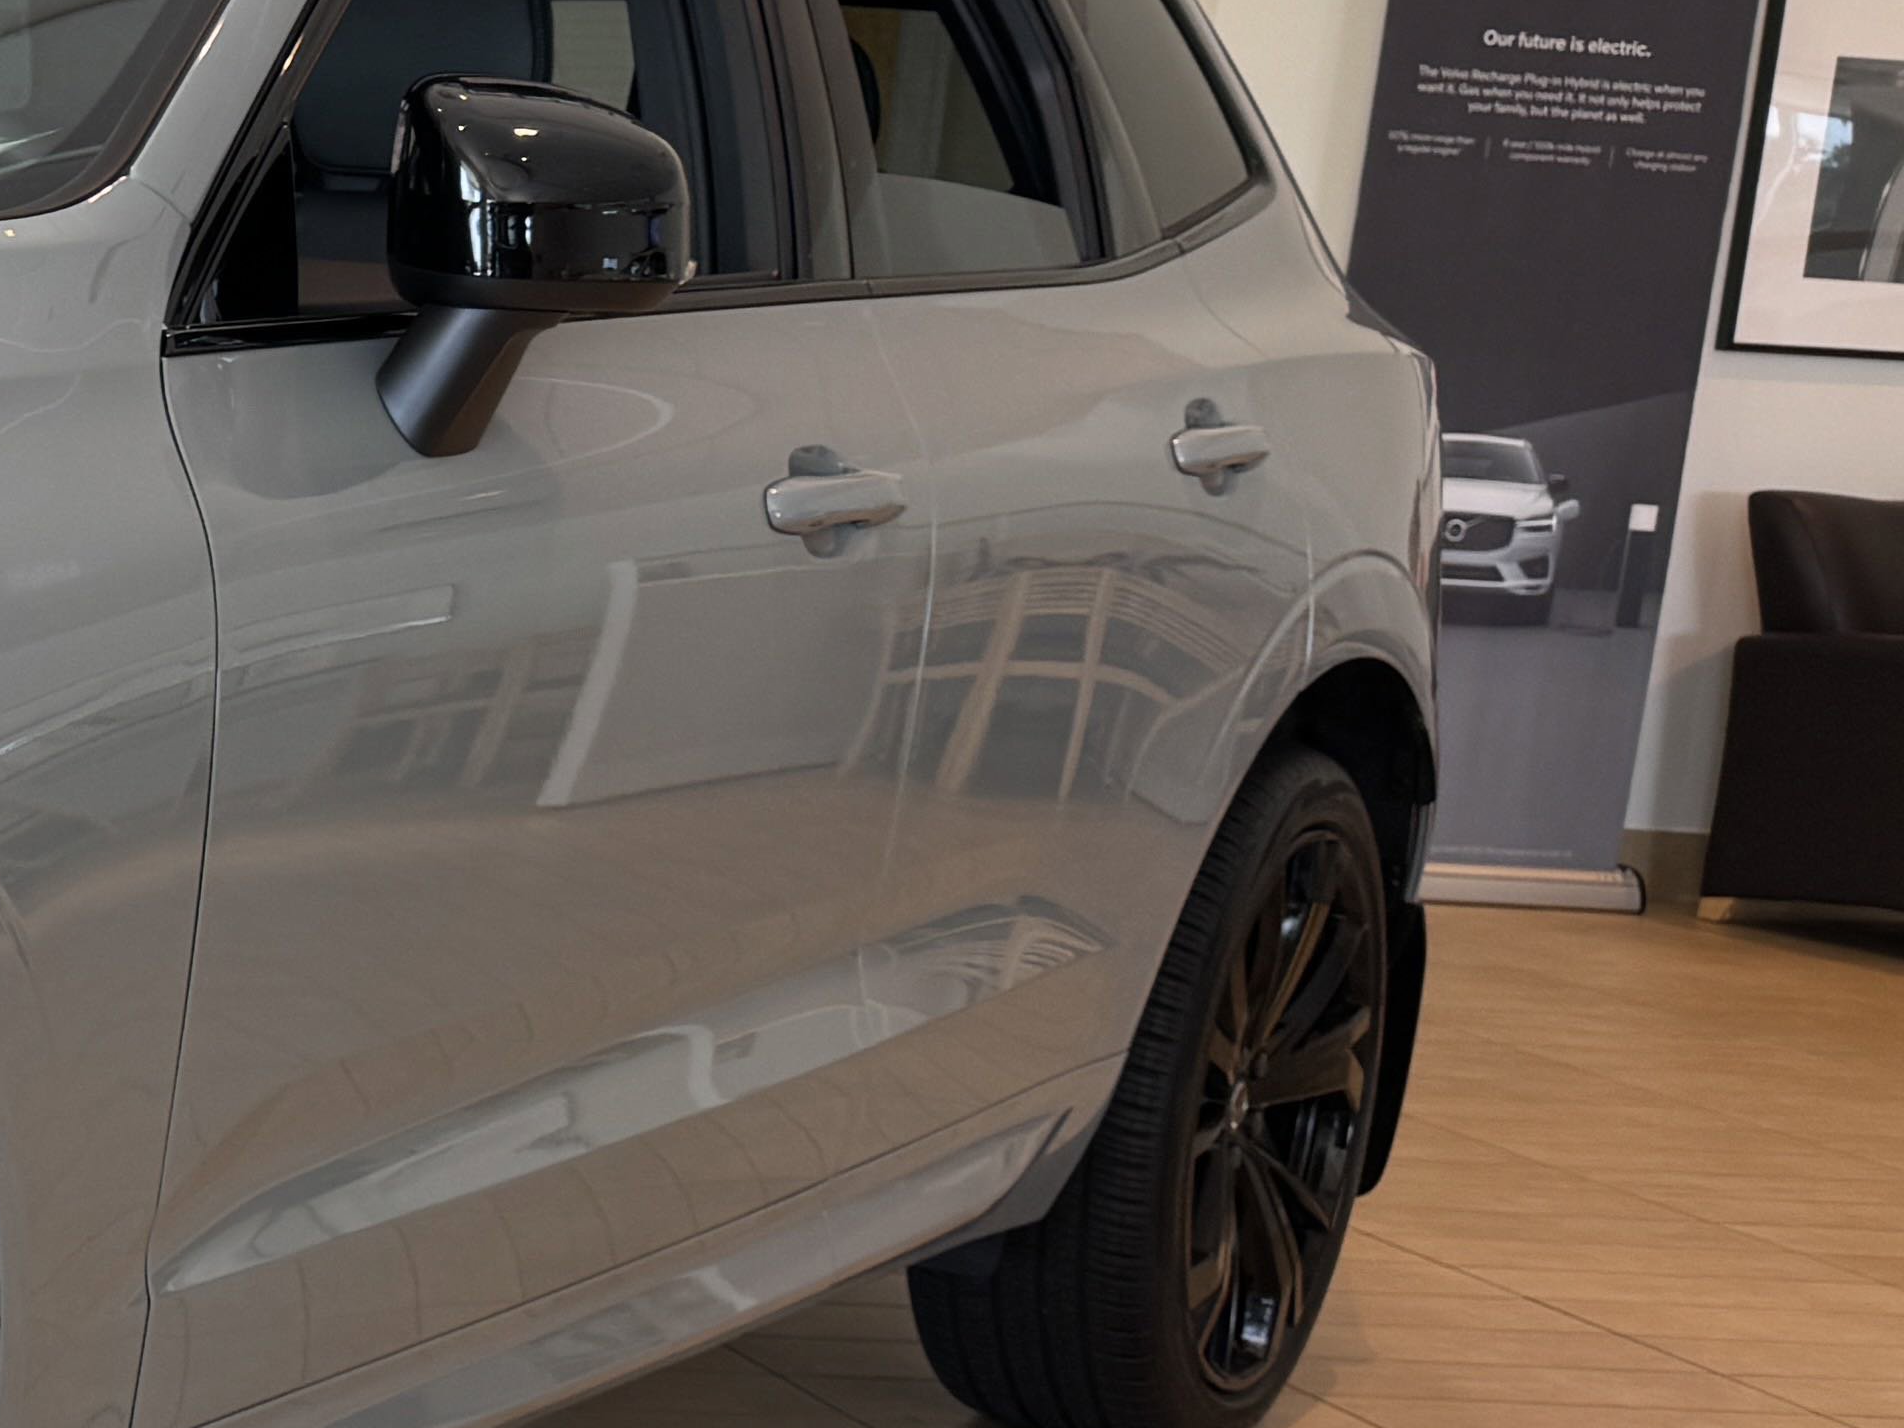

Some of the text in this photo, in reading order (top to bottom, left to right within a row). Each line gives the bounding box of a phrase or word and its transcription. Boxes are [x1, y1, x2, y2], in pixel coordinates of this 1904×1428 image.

[1483, 28, 1652, 58] Our future is electric.
